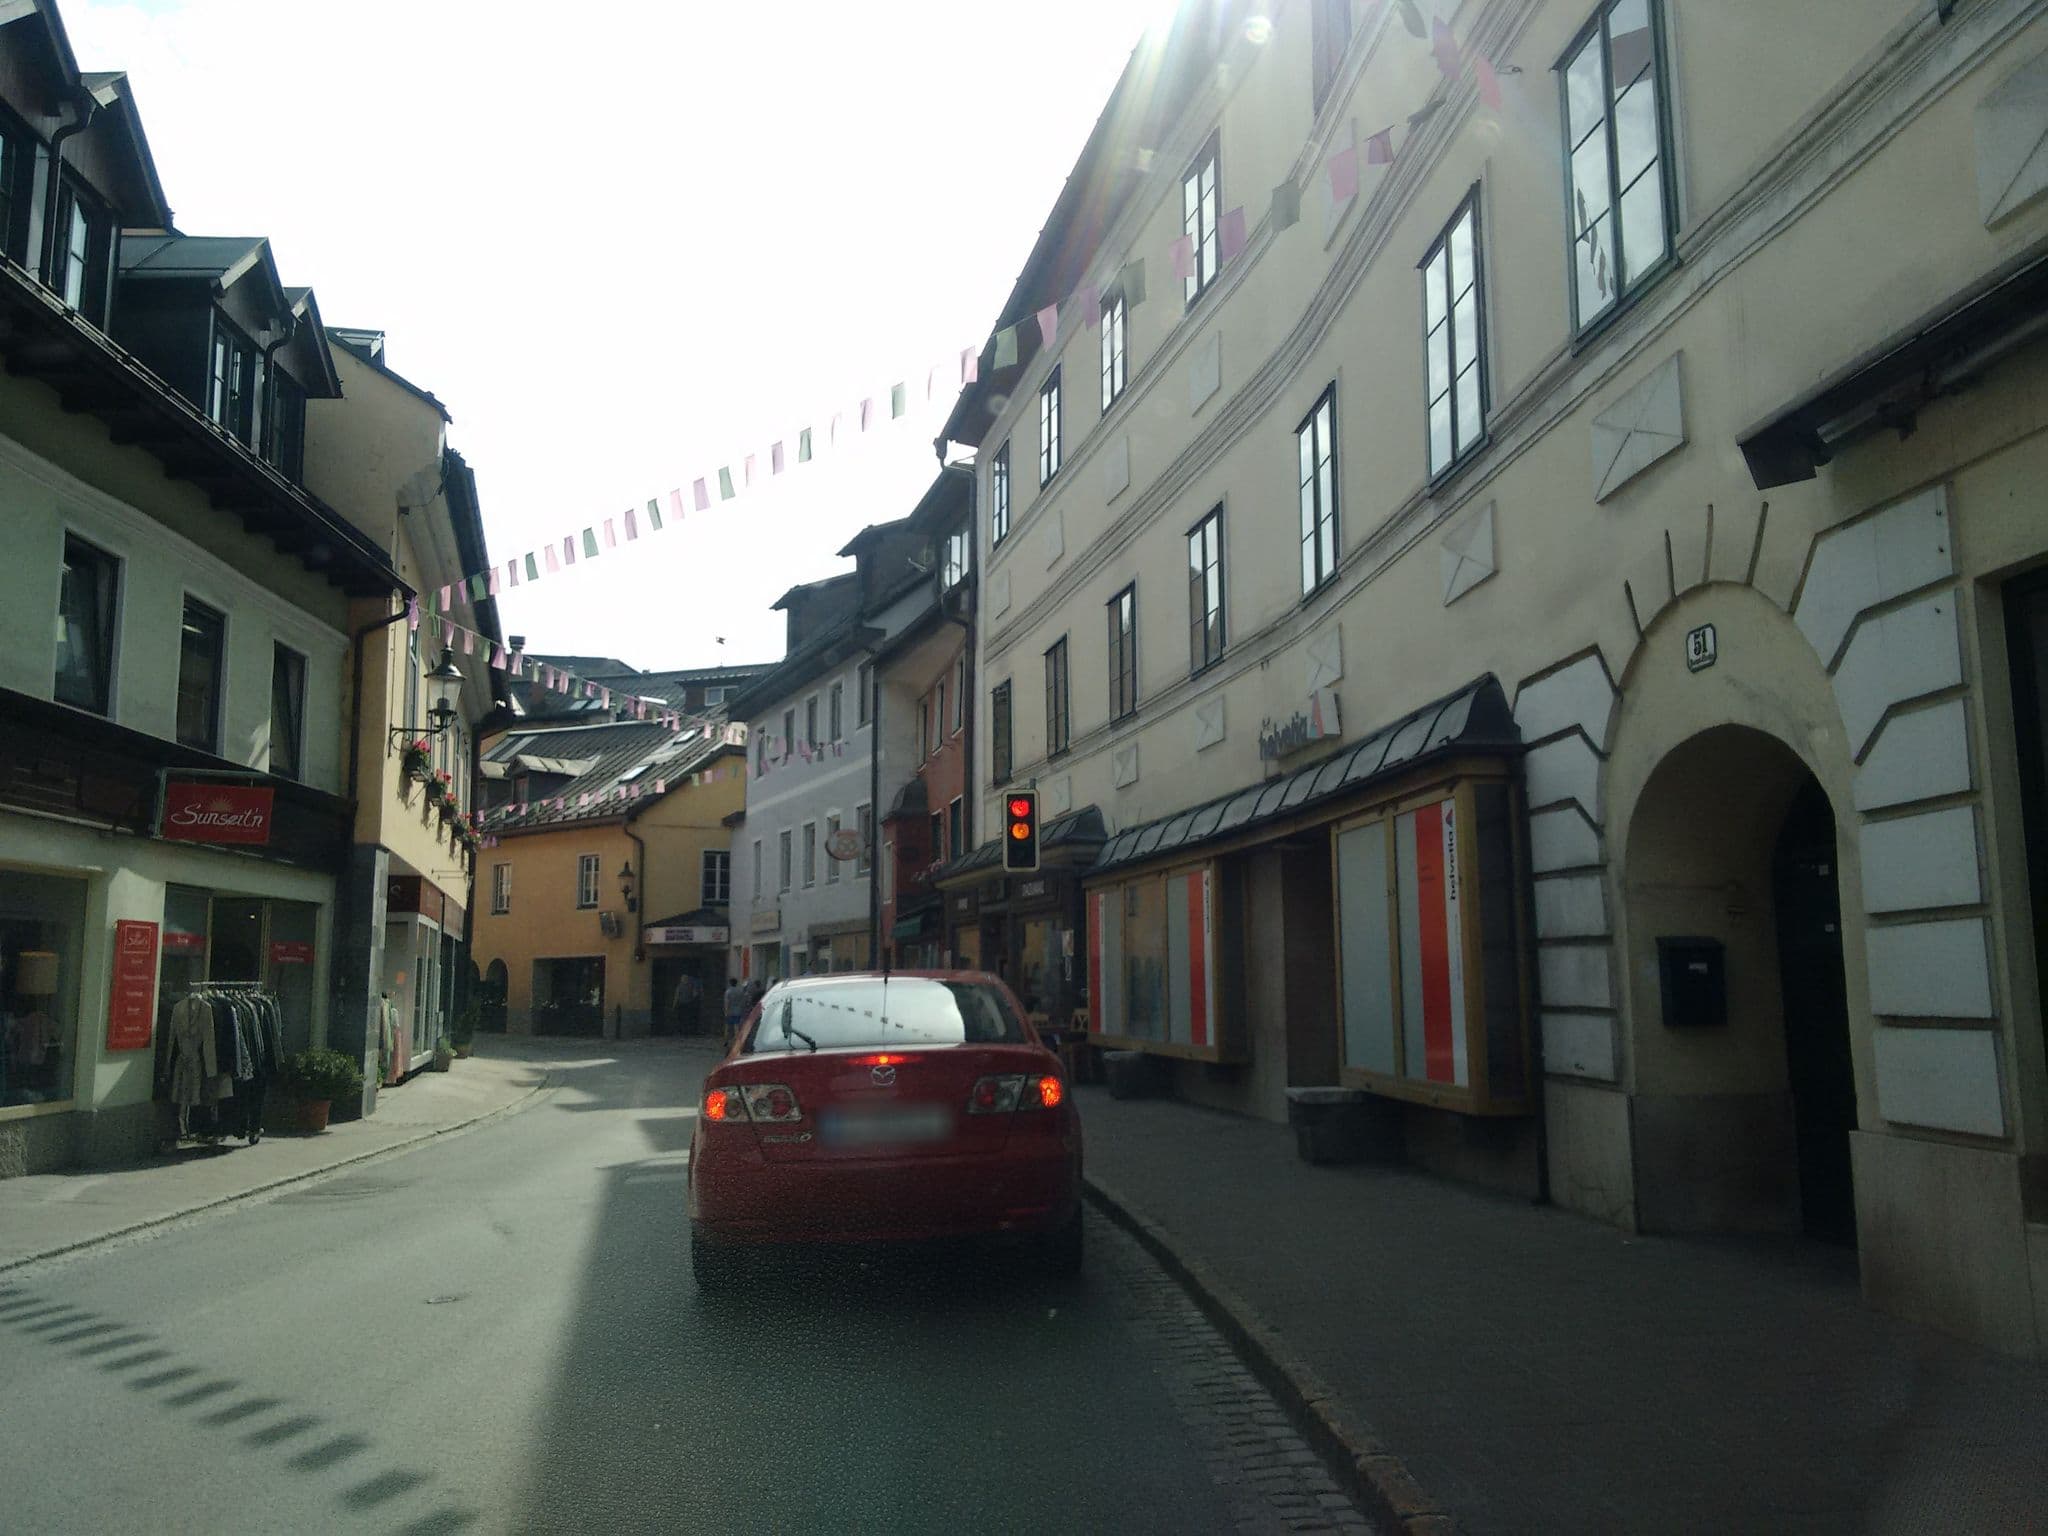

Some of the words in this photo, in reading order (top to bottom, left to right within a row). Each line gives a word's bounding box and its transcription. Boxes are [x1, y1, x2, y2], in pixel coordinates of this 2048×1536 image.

[1694, 630, 1707, 655] 51
[1259, 711, 1307, 760] helvetia
[1447, 831, 1456, 901] helvetia
